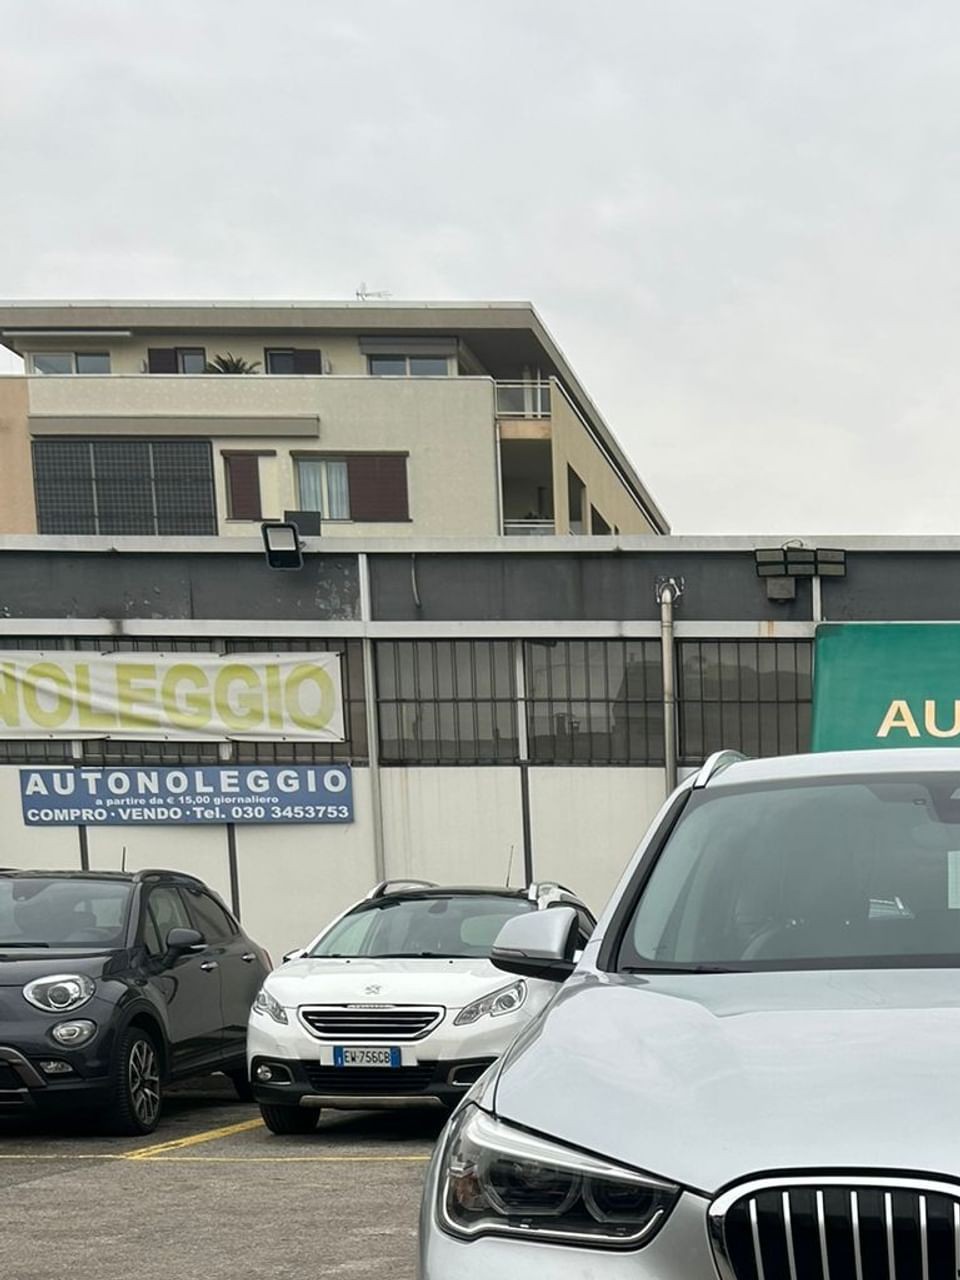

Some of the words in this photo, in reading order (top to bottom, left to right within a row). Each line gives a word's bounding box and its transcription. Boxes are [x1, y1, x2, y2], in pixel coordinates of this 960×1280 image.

[25, 769, 347, 796] AUTONOLEGGIO
[95, 798, 103, 806] a
[106, 796, 146, 807] partire
[149, 796, 164, 805] da
[166, 796, 175, 804] €
[178, 795, 210, 806] 15,00
[213, 795, 279, 806] giornaliero
[27, 808, 107, 821] COMPRO
[118, 806, 182, 820] VENDO
[193, 806, 226, 819] Tel.
[231, 806, 265, 819] 030
[271, 805, 349, 819] 3453753
